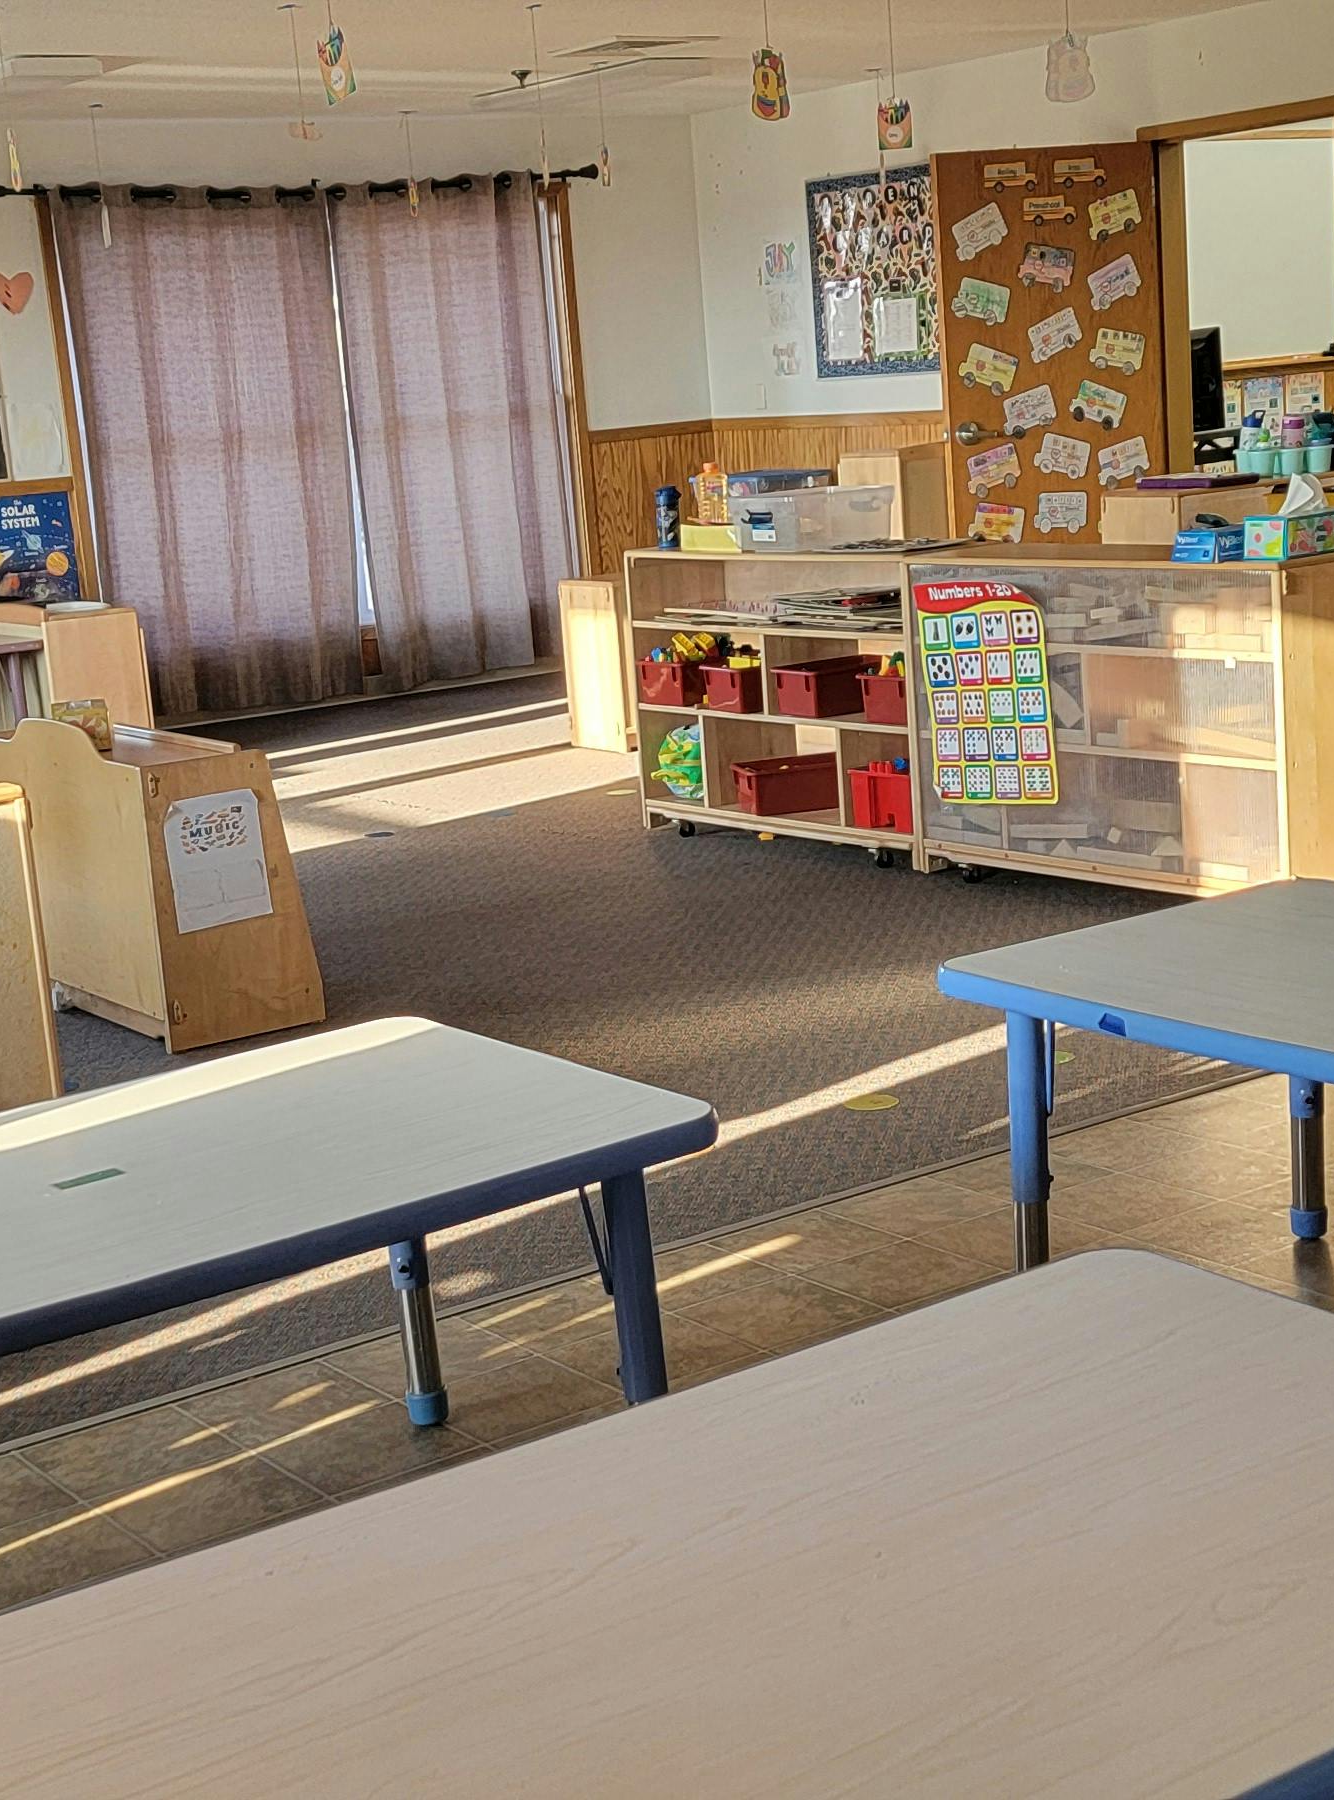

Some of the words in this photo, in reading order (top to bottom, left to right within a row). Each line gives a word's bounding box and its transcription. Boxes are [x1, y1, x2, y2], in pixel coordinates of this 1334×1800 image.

[0, 504, 36, 518] SOLAR
[1, 516, 41, 530] SYSTEM
[927, 585, 984, 601] Numbers
[985, 583, 1012, 597] 1-20
[188, 820, 240, 838] MUSIC
